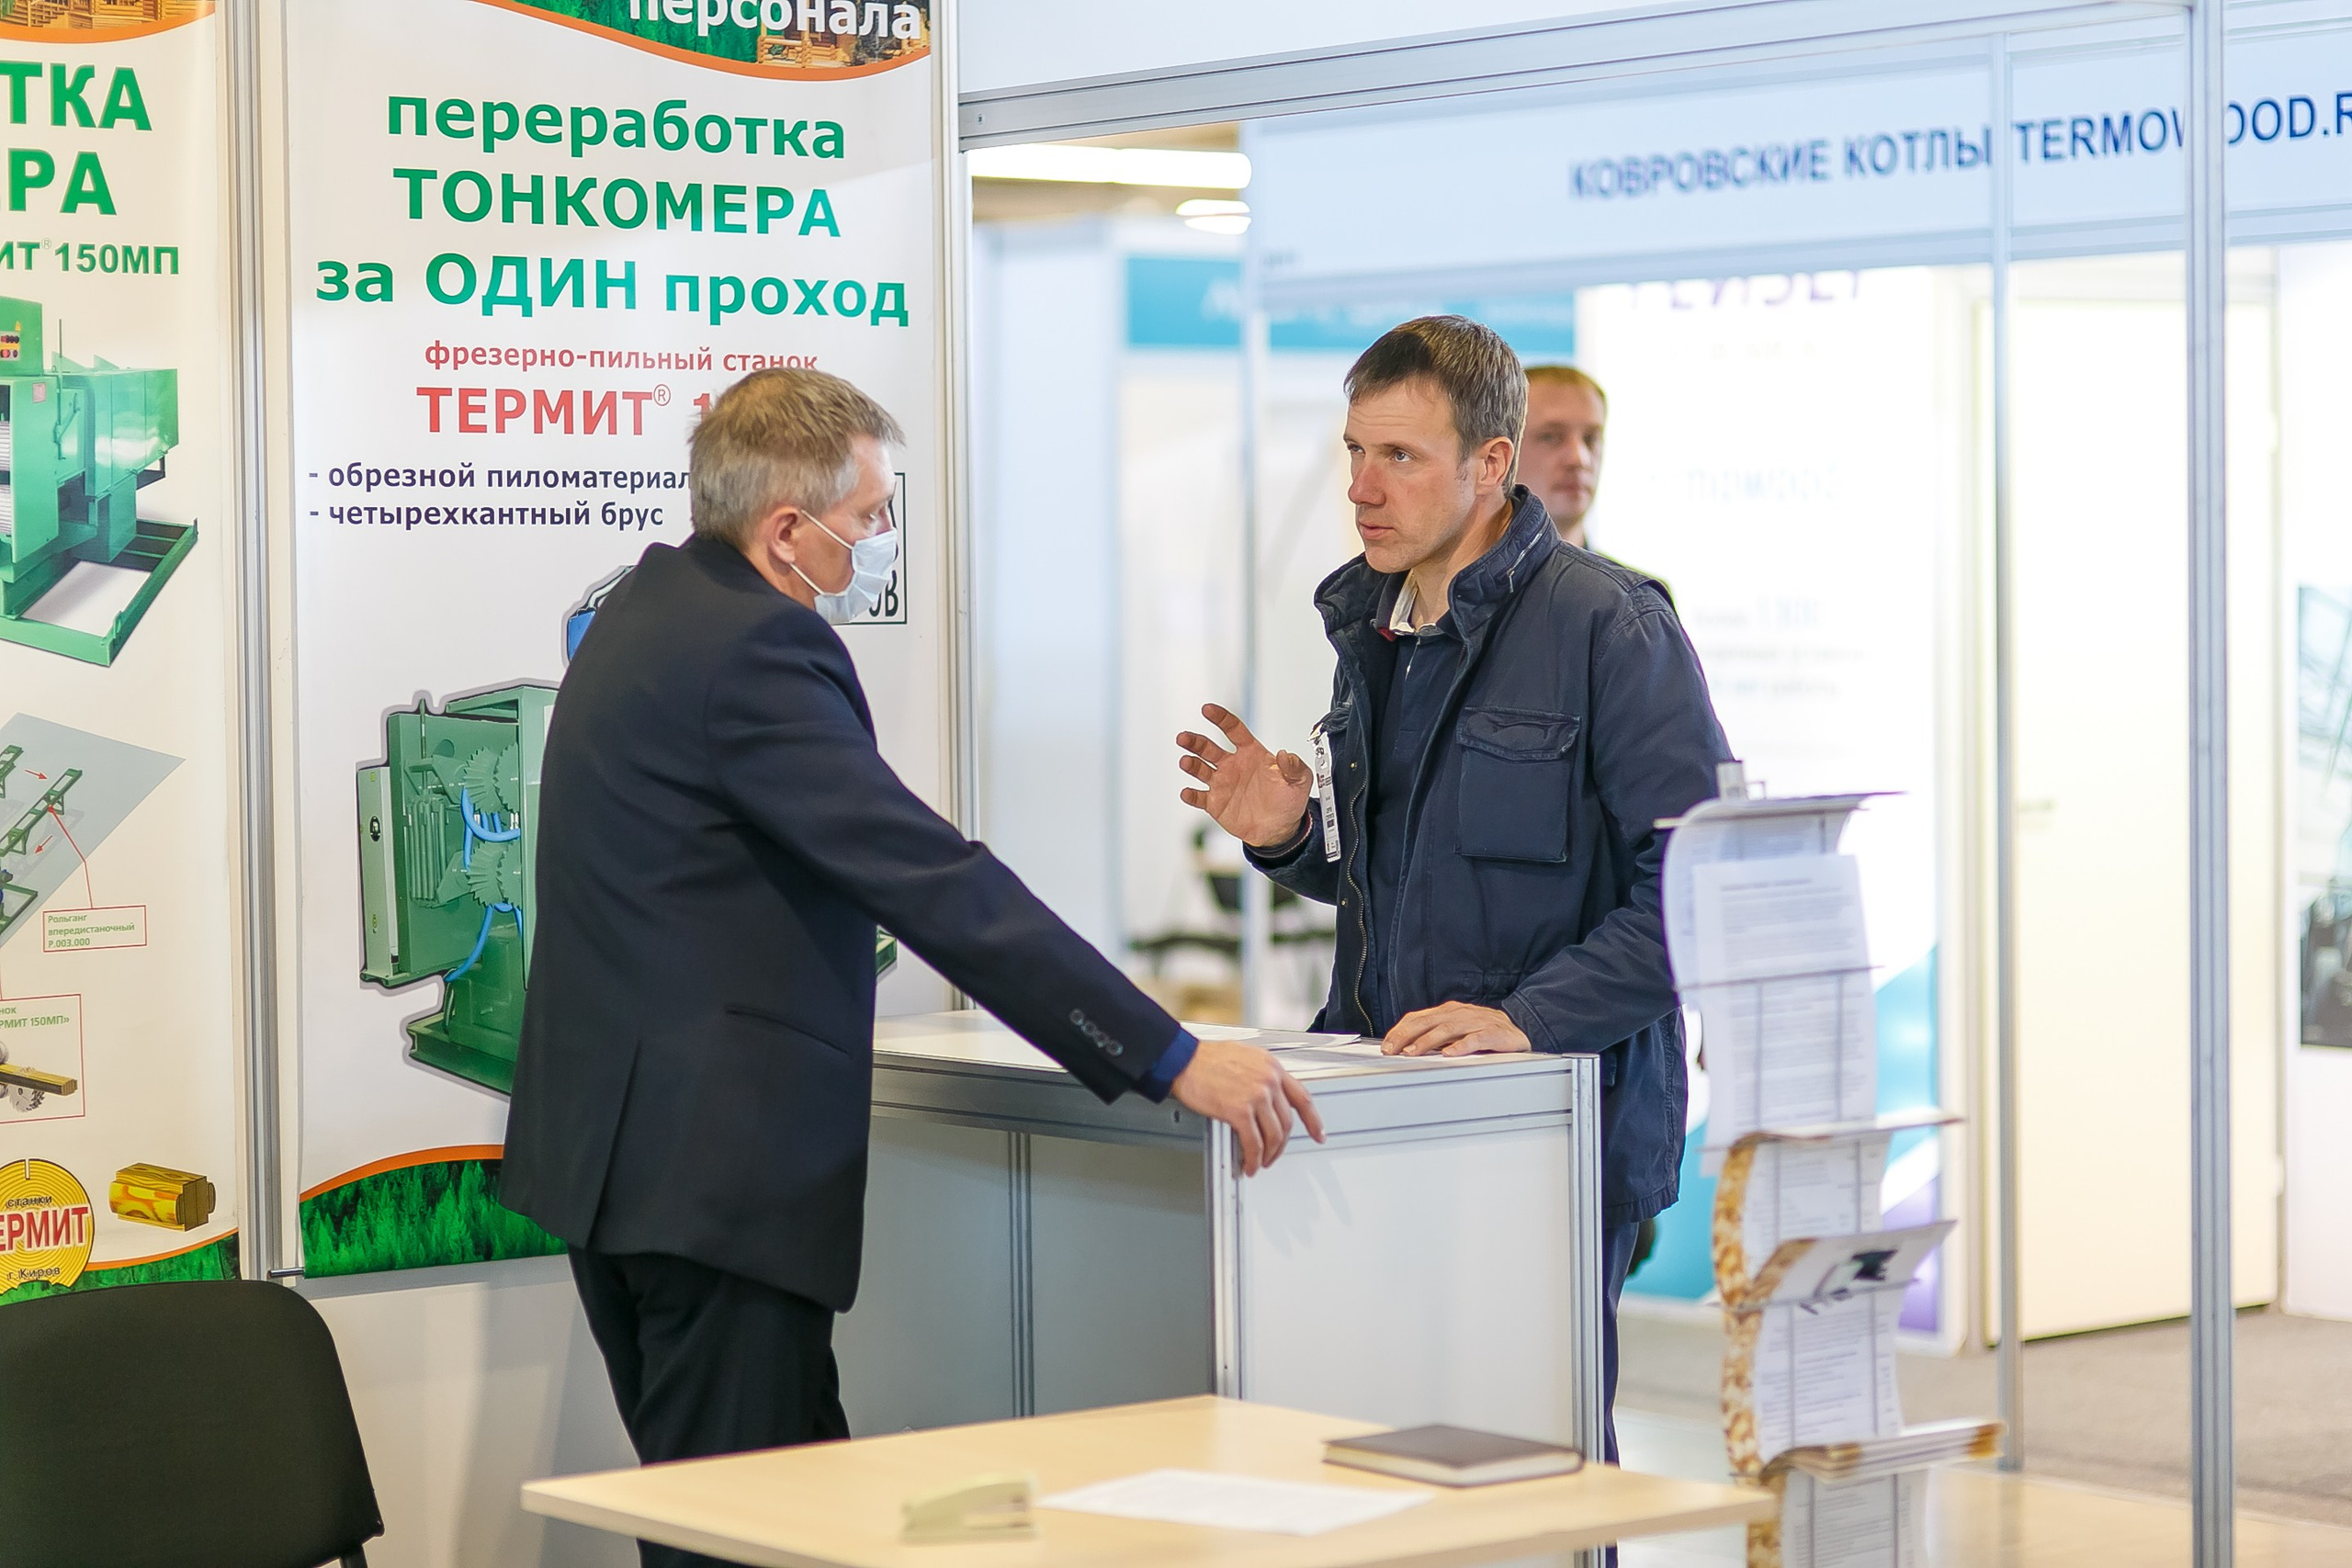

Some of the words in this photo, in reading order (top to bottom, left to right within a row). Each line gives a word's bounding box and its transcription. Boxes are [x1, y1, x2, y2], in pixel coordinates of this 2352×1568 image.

[631, 0, 920, 39] персонала
[0, 60, 153, 131] ТКА
[389, 96, 844, 159] переработка
[1571, 139, 1832, 197] КОВРОВСКИЕ
[1844, 123, 1993, 178] КОТЛЫ
[8, 148, 117, 215] РА
[393, 168, 841, 237] ТОНКОМЕРА
[55, 243, 178, 275] 150МП
[316, 261, 393, 301] за
[426, 253, 636, 317] ОДИН
[666, 275, 909, 327] проход
[425, 340, 711, 372] фрезерно-пильный
[723, 354, 818, 371] станок
[329, 462, 475, 492] обрезной
[488, 469, 691, 494] пиломатериал
[329, 502, 590, 531] четырехкантный
[602, 502, 663, 531] брус
[48, 914, 87, 923] Рольганг
[48, 922, 135, 936] впередистаночный
[48, 938, 90, 948] Р.003.000
[6, 1196, 52, 1208] станки
